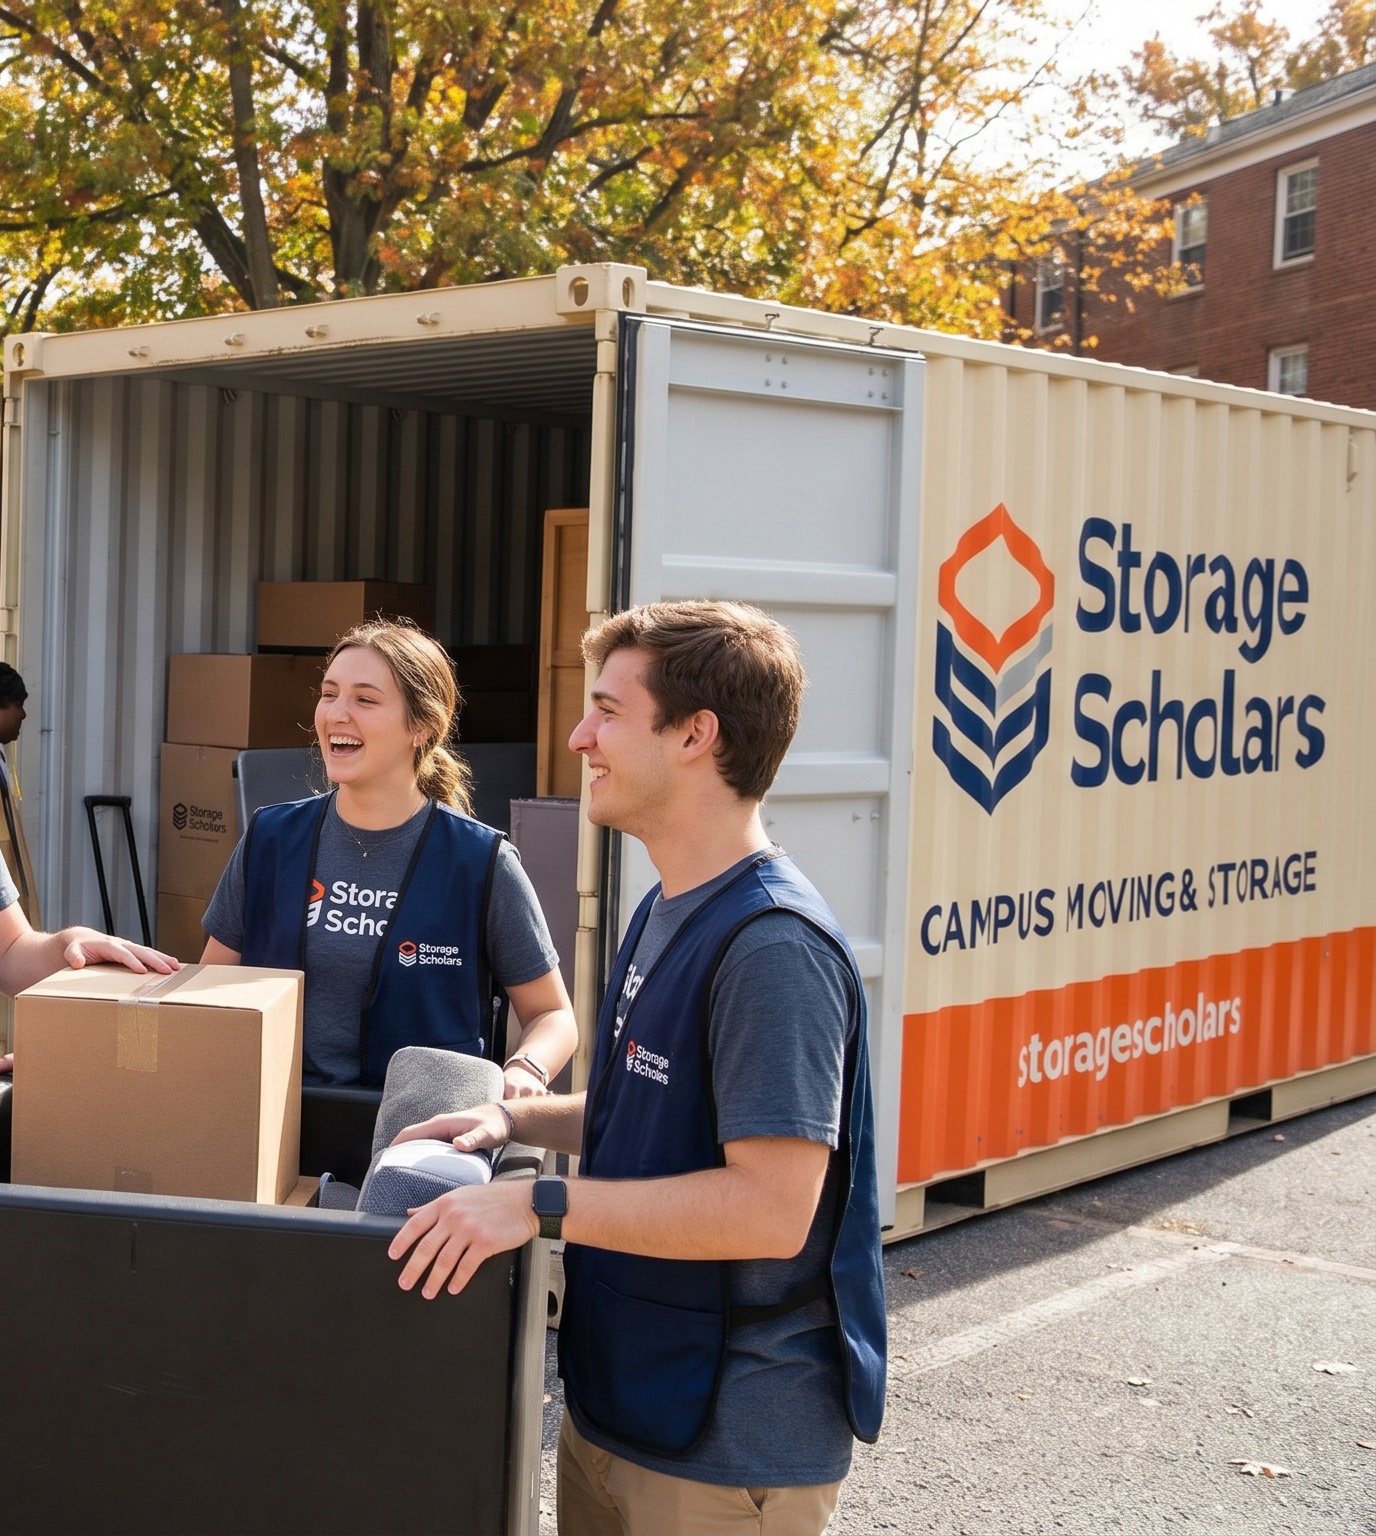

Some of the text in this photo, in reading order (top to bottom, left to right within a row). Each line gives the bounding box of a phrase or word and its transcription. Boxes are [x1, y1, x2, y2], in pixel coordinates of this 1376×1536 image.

[1076, 517, 1309, 664] Storage
[1070, 669, 1326, 788] Scholars
[189, 805, 223, 822] Storage
[920, 888, 1056, 956] CAMPUS
[1208, 851, 1318, 909] STORAGE
[418, 954, 463, 966] Scholars
[1017, 992, 1242, 1088] storagescholars
